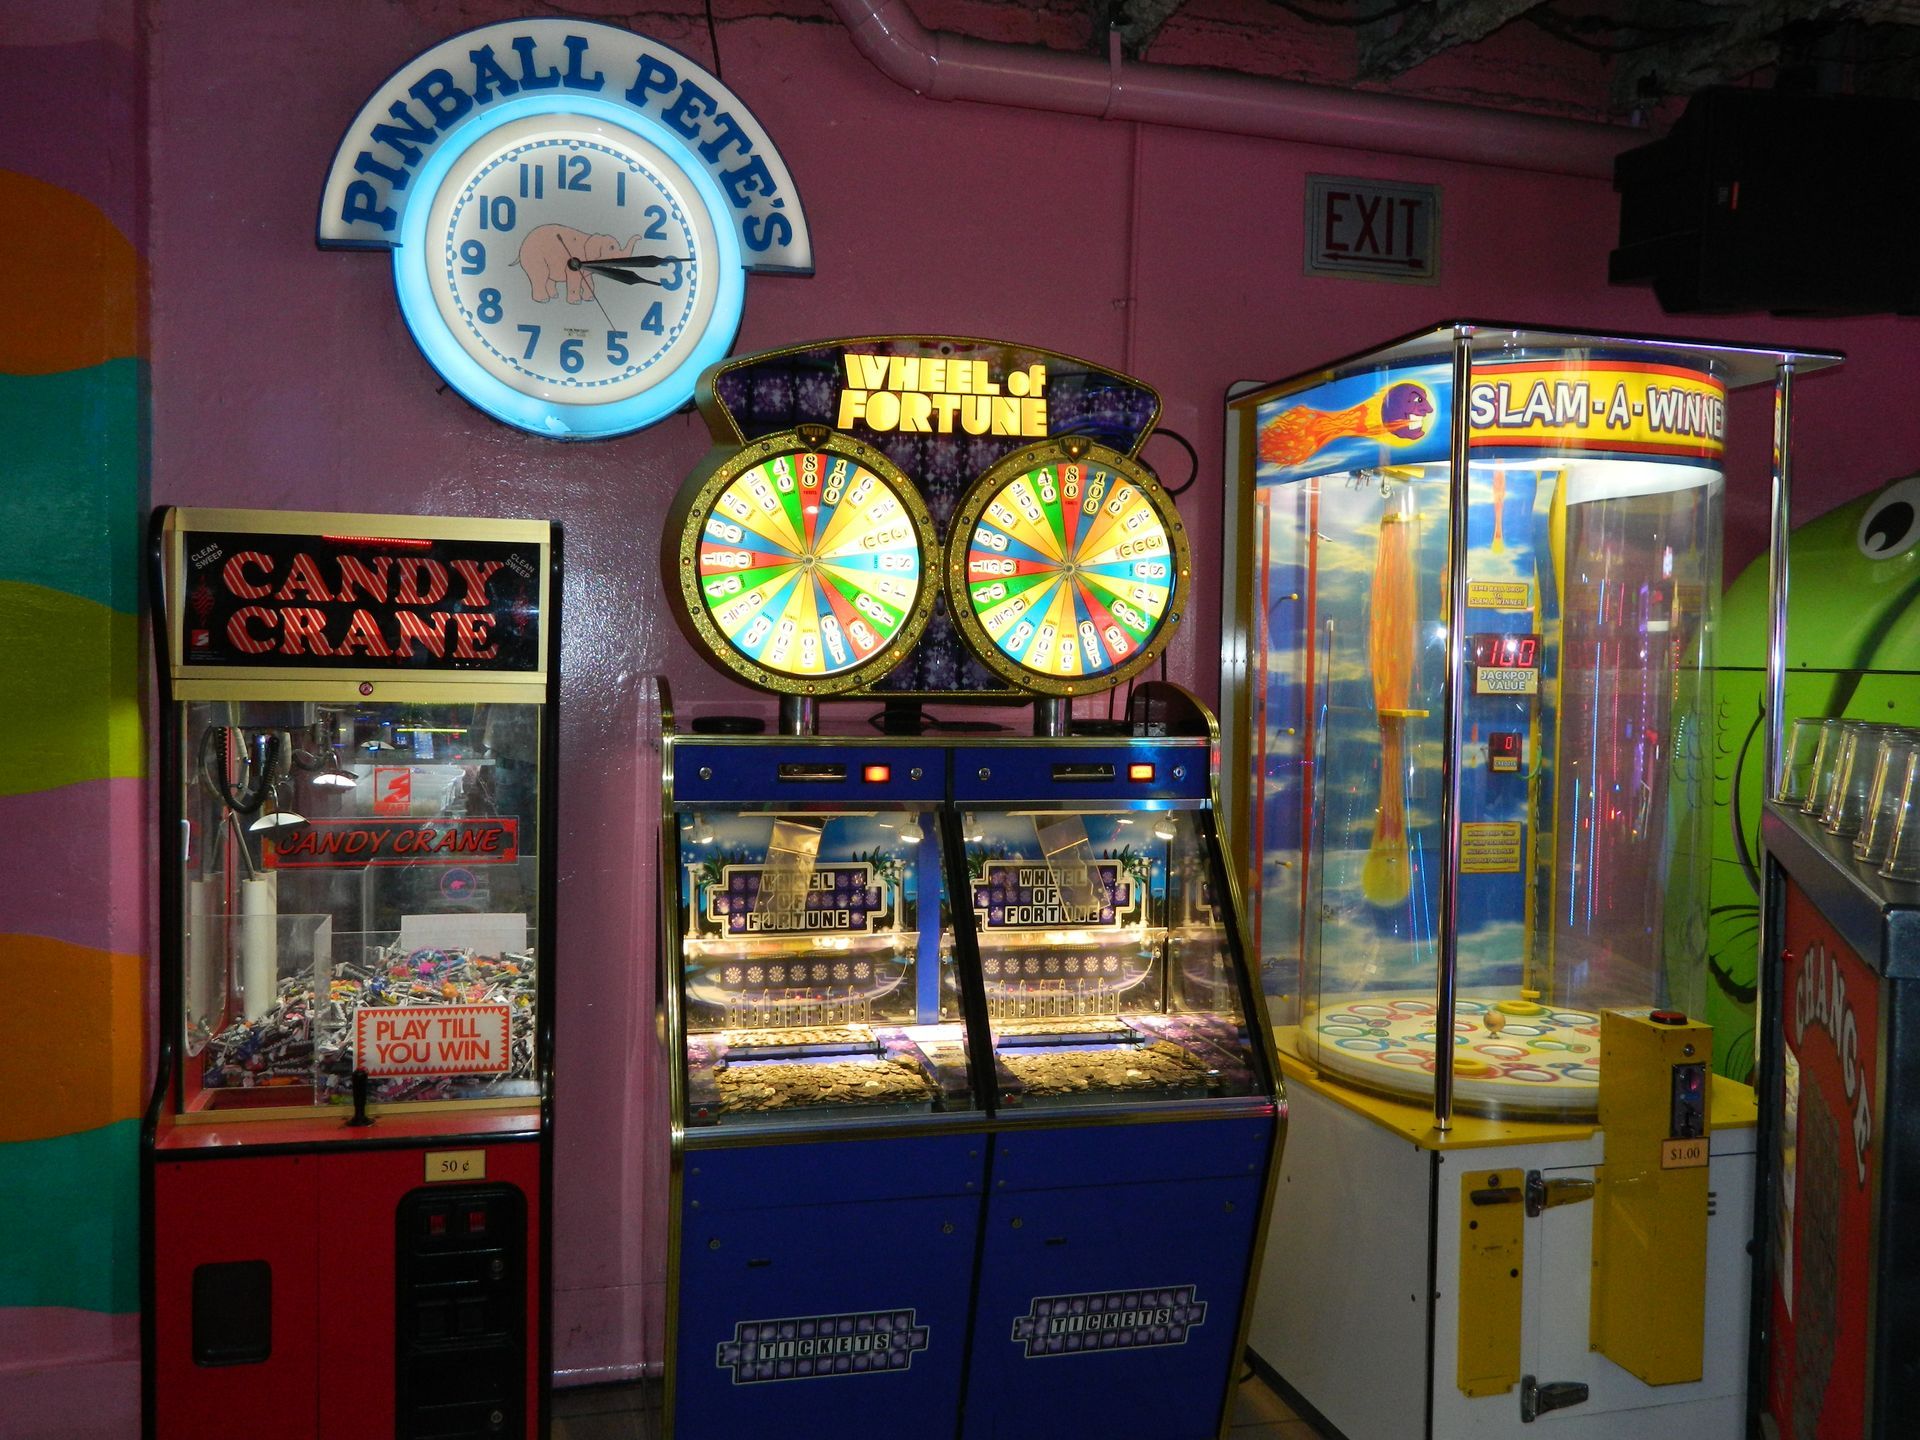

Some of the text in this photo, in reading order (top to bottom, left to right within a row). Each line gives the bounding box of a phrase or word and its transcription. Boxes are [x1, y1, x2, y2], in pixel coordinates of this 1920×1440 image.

[341, 35, 793, 252] PINBALL PETE'S
[520, 163, 544, 200] 11
[558, 155, 592, 191] 12
[617, 172, 626, 206] 1
[480, 195, 516, 232] 10
[644, 205, 667, 241] 2
[1325, 191, 1422, 257] EXIT
[461, 240, 486, 275] 9
[660, 255, 683, 291] 3
[477, 288, 503, 325] 8
[641, 301, 664, 336] 4
[517, 325, 541, 360] 7
[560, 340, 584, 375] 6
[607, 331, 628, 366] 5
[844, 354, 1047, 395] WHEEL of
[837, 389, 1049, 437] FORTUNE
[773, 456, 794, 492] 40
[802, 453, 818, 488] 80
[823, 459, 848, 504] 100
[1037, 468, 1057, 502] 40
[1063, 465, 1079, 499] 80
[851, 476, 875, 504] 60
[1083, 471, 1106, 514] 100
[1109, 487, 1132, 515] 60
[191, 543, 218, 562] CLEAN
[974, 528, 1008, 552] 50
[195, 550, 223, 569] SWEEP
[505, 559, 530, 578] SWEEP
[511, 553, 535, 573] CLEAN
[970, 559, 1016, 575] 150
[1135, 561, 1166, 578] 80
[223, 551, 505, 606] CANDY
[706, 576, 740, 597] 40
[973, 583, 1006, 603] 40
[856, 594, 895, 627] 100
[1112, 599, 1148, 632] 100
[227, 606, 498, 659] CRANE
[1490, 640, 1536, 667] 100
[1481, 671, 1533, 680] JACKPOT
[1488, 681, 1525, 690] VALUE
[1505, 736, 1513, 750] 0
[277, 828, 504, 855] CANDY CRANE
[1020, 869, 1087, 886] WHEEL
[1033, 889, 1059, 904] OF
[748, 911, 848, 930] FORTUNE
[1006, 906, 1098, 922] FORTUNE
[376, 1018, 481, 1041] PLAY TILL
[376, 1040, 490, 1064] YOU WIN
[441, 1160, 470, 1173] 50 ¢
[1671, 1146, 1700, 1161] $1.00
[1052, 1308, 1169, 1333] TICKETS
[761, 1332, 889, 1360] TICKETS
